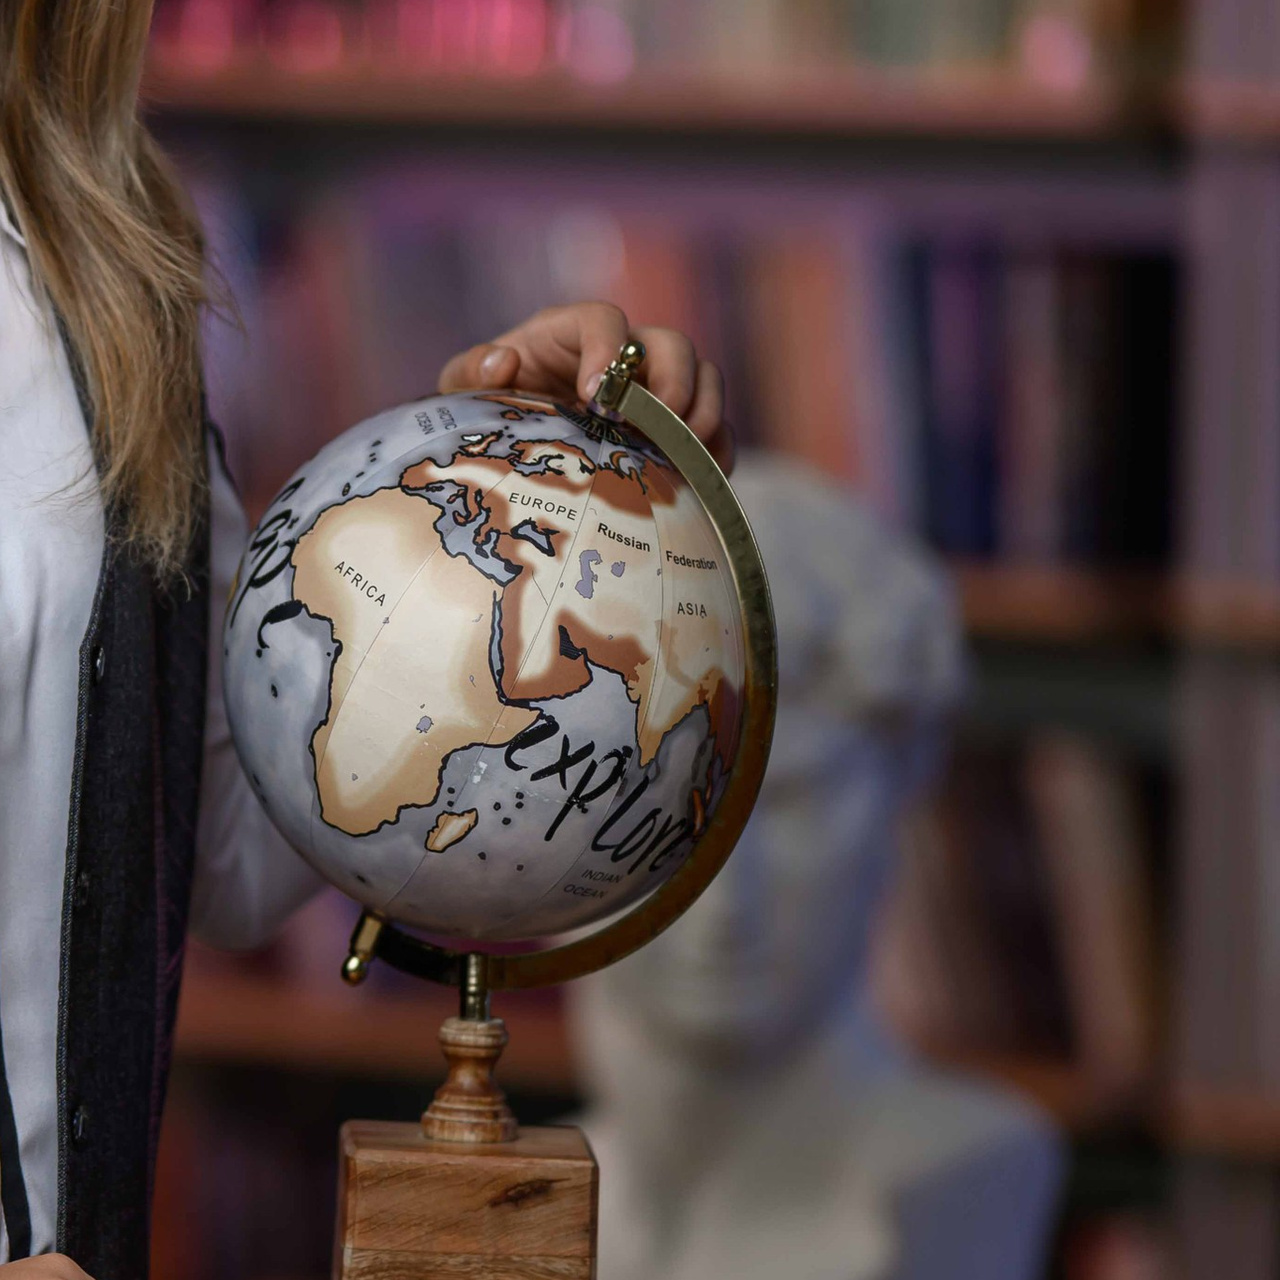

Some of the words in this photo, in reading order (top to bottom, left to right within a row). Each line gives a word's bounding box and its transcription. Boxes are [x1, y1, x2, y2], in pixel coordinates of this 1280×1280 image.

[414, 411, 436, 436] OCEAN
[435, 406, 458, 431] ARCTIC
[508, 492, 578, 521] EUROPE
[597, 522, 651, 552] Russian
[666, 550, 718, 571] Federation
[334, 560, 387, 607] AFRICA
[677, 602, 708, 617] ASIA
[581, 869, 624, 883] INDIAN
[563, 884, 609, 899] OCEAN
